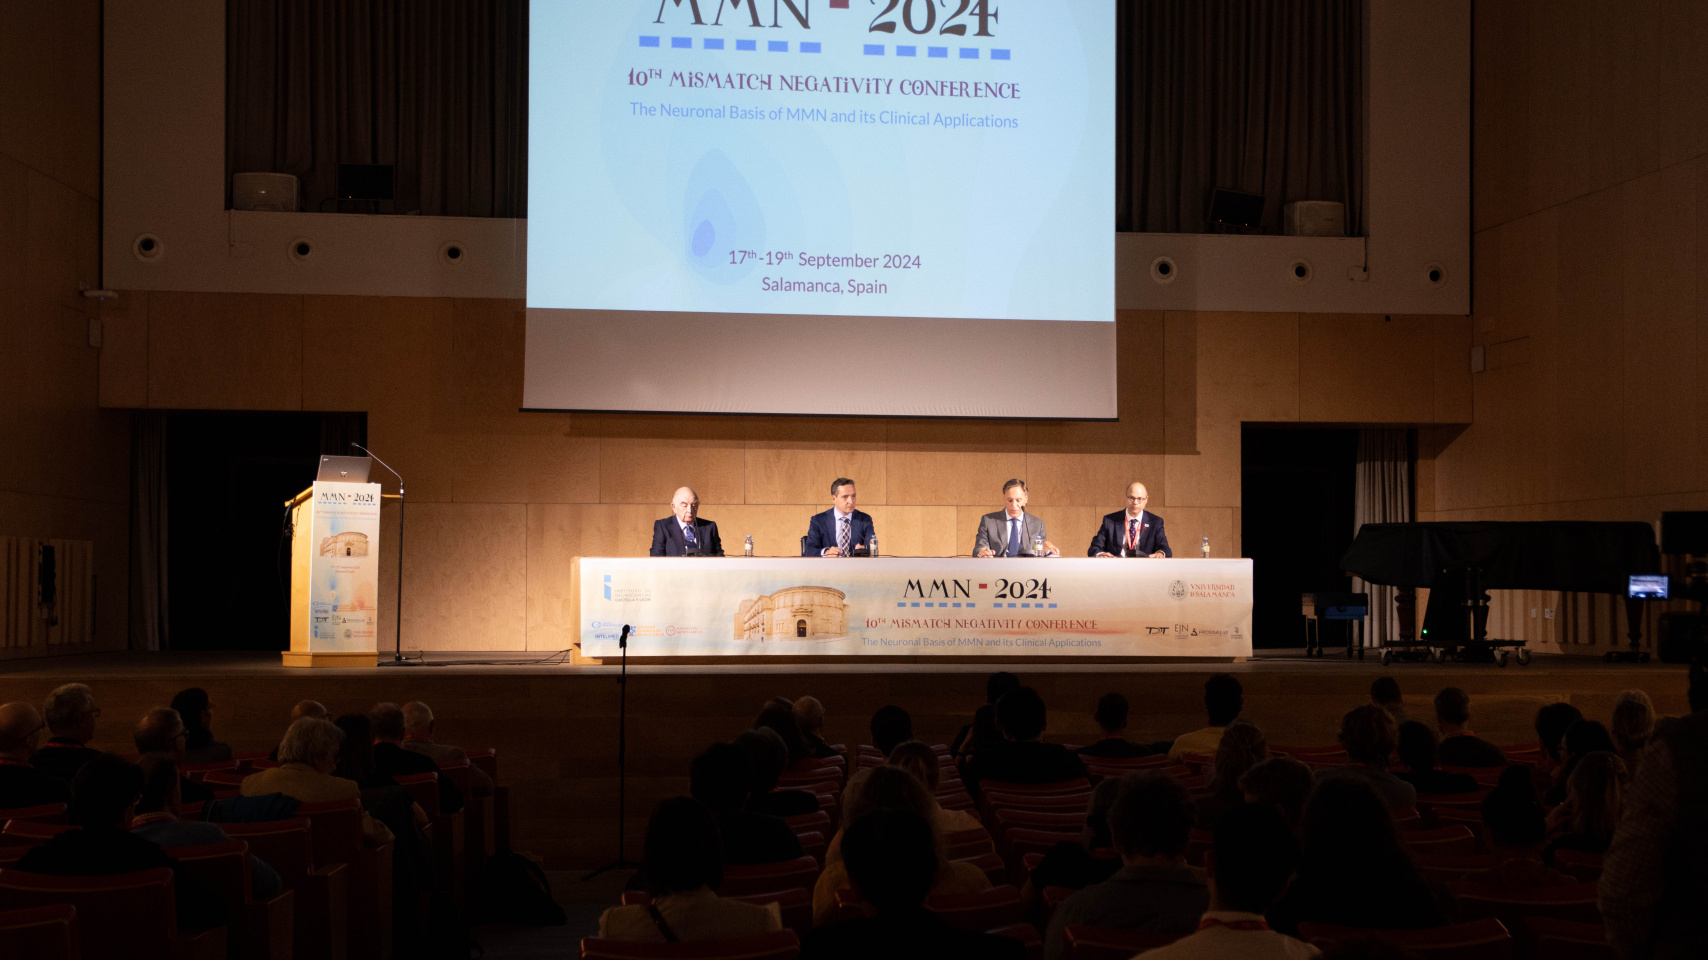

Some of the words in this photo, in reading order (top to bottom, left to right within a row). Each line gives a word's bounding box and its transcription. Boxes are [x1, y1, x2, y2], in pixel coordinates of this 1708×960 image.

[868, 0, 999, 37] 2024
[899, 79, 1021, 100] CONFERENCE
[630, 102, 657, 117] The
[660, 103, 726, 119] Neuronal
[729, 106, 766, 120] Basis
[769, 107, 783, 121] of
[786, 108, 827, 122] MMN
[830, 110, 856, 123] and
[860, 110, 876, 124] its
[879, 111, 930, 126] Clinical
[933, 113, 1019, 129] Applications
[799, 252, 879, 269] September
[883, 254, 921, 269] 2024
[762, 277, 844, 295] Salamanca,
[847, 279, 888, 296] Spain
[321, 492, 346, 501] MMN
[353, 493, 374, 502] 2024
[903, 579, 971, 598] MMN
[995, 578, 1051, 599] 2024
[1025, 620, 1098, 630] CONFERENCE
[862, 638, 879, 646] The
[880, 638, 921, 647] Neuronal
[923, 638, 948, 647] Basis
[949, 638, 956, 647] of
[957, 639, 983, 647] MMN
[985, 638, 1001, 647] and
[1003, 639, 1014, 647] its
[1015, 638, 1047, 647] Clinical
[1048, 639, 1102, 649] Applications
